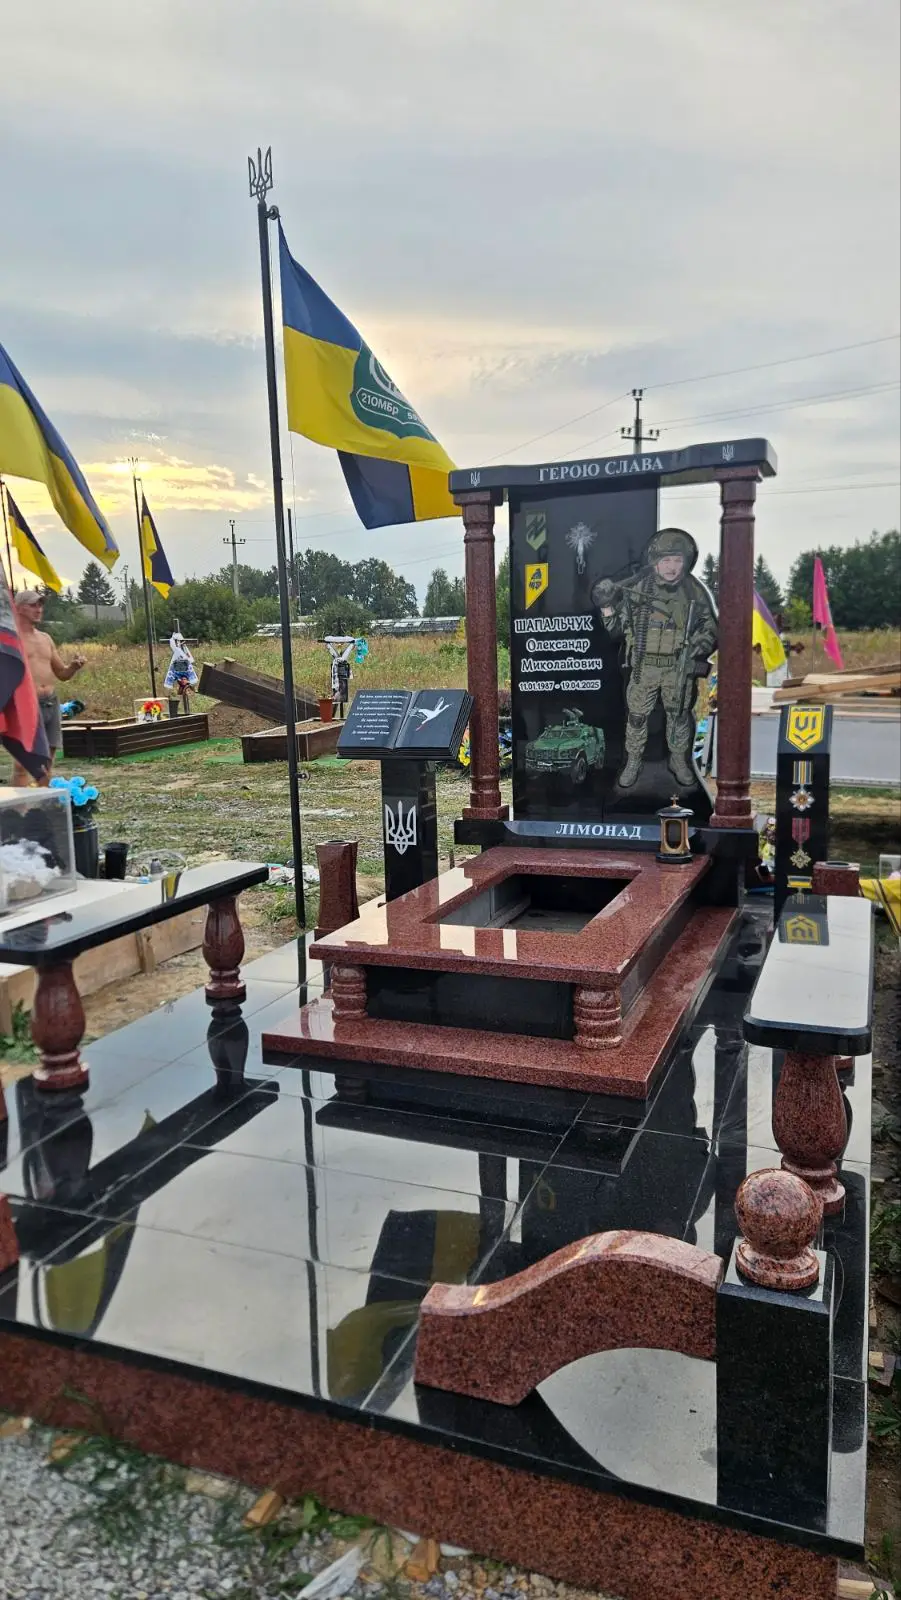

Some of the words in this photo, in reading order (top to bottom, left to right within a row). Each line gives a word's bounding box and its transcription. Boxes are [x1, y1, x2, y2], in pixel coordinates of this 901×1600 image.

[538, 463, 600, 481] ГЕРОЮ
[604, 456, 664, 475] СЛАВА
[514, 616, 593, 633] ШАПАЛЬЧУК
[526, 638, 590, 653] Олександр
[521, 657, 602, 672] Миколайович
[560, 680, 601, 690] 19.04.2025
[555, 823, 642, 840] ЛІМОНАД
